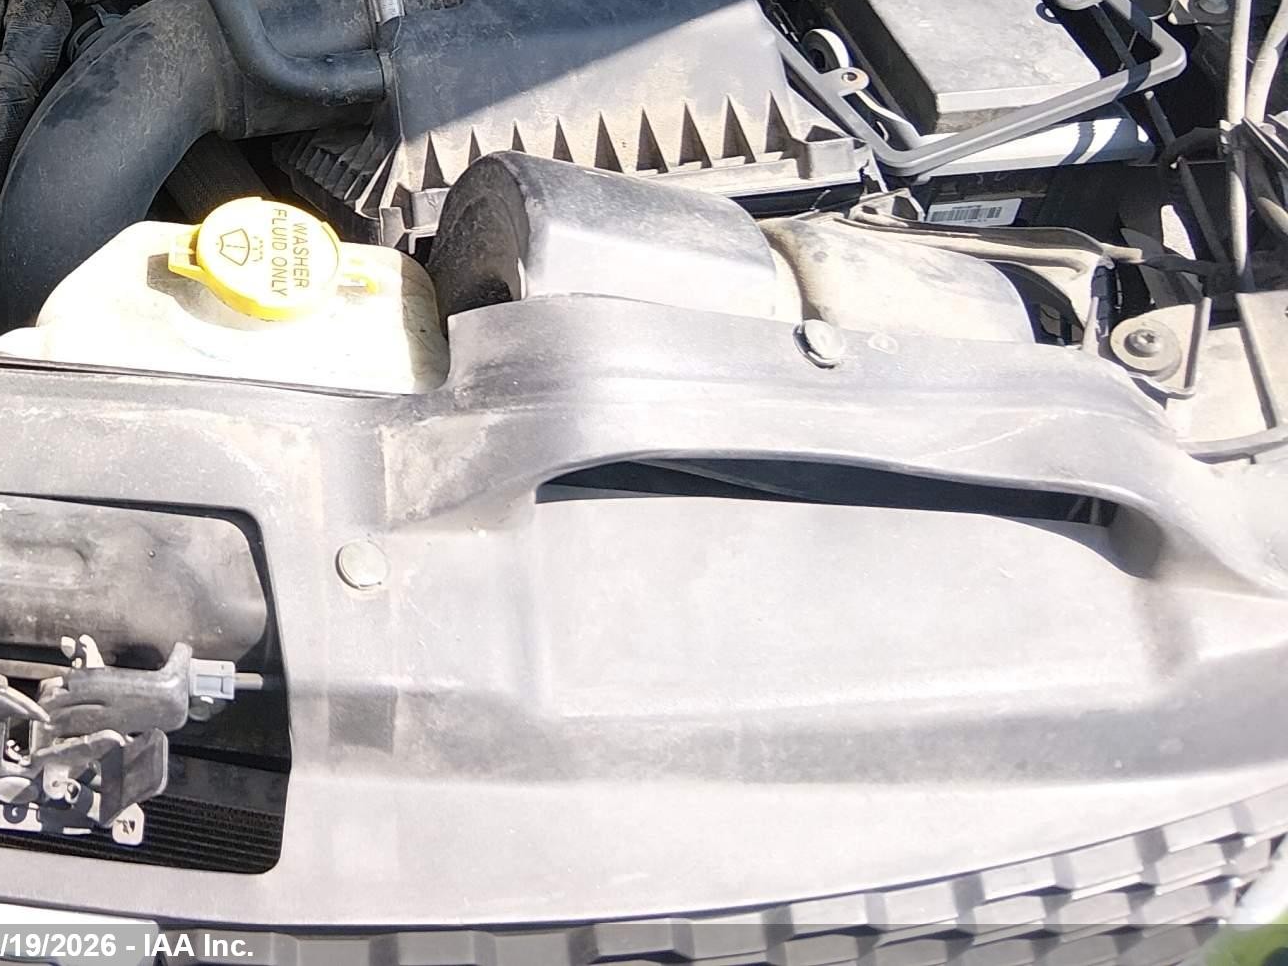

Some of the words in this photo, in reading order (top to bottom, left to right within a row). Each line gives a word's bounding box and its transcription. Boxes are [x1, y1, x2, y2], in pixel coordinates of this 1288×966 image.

[271, 208, 288, 252] FLUID
[271, 257, 288, 297] ONLY
[292, 221, 310, 290] WASHER
